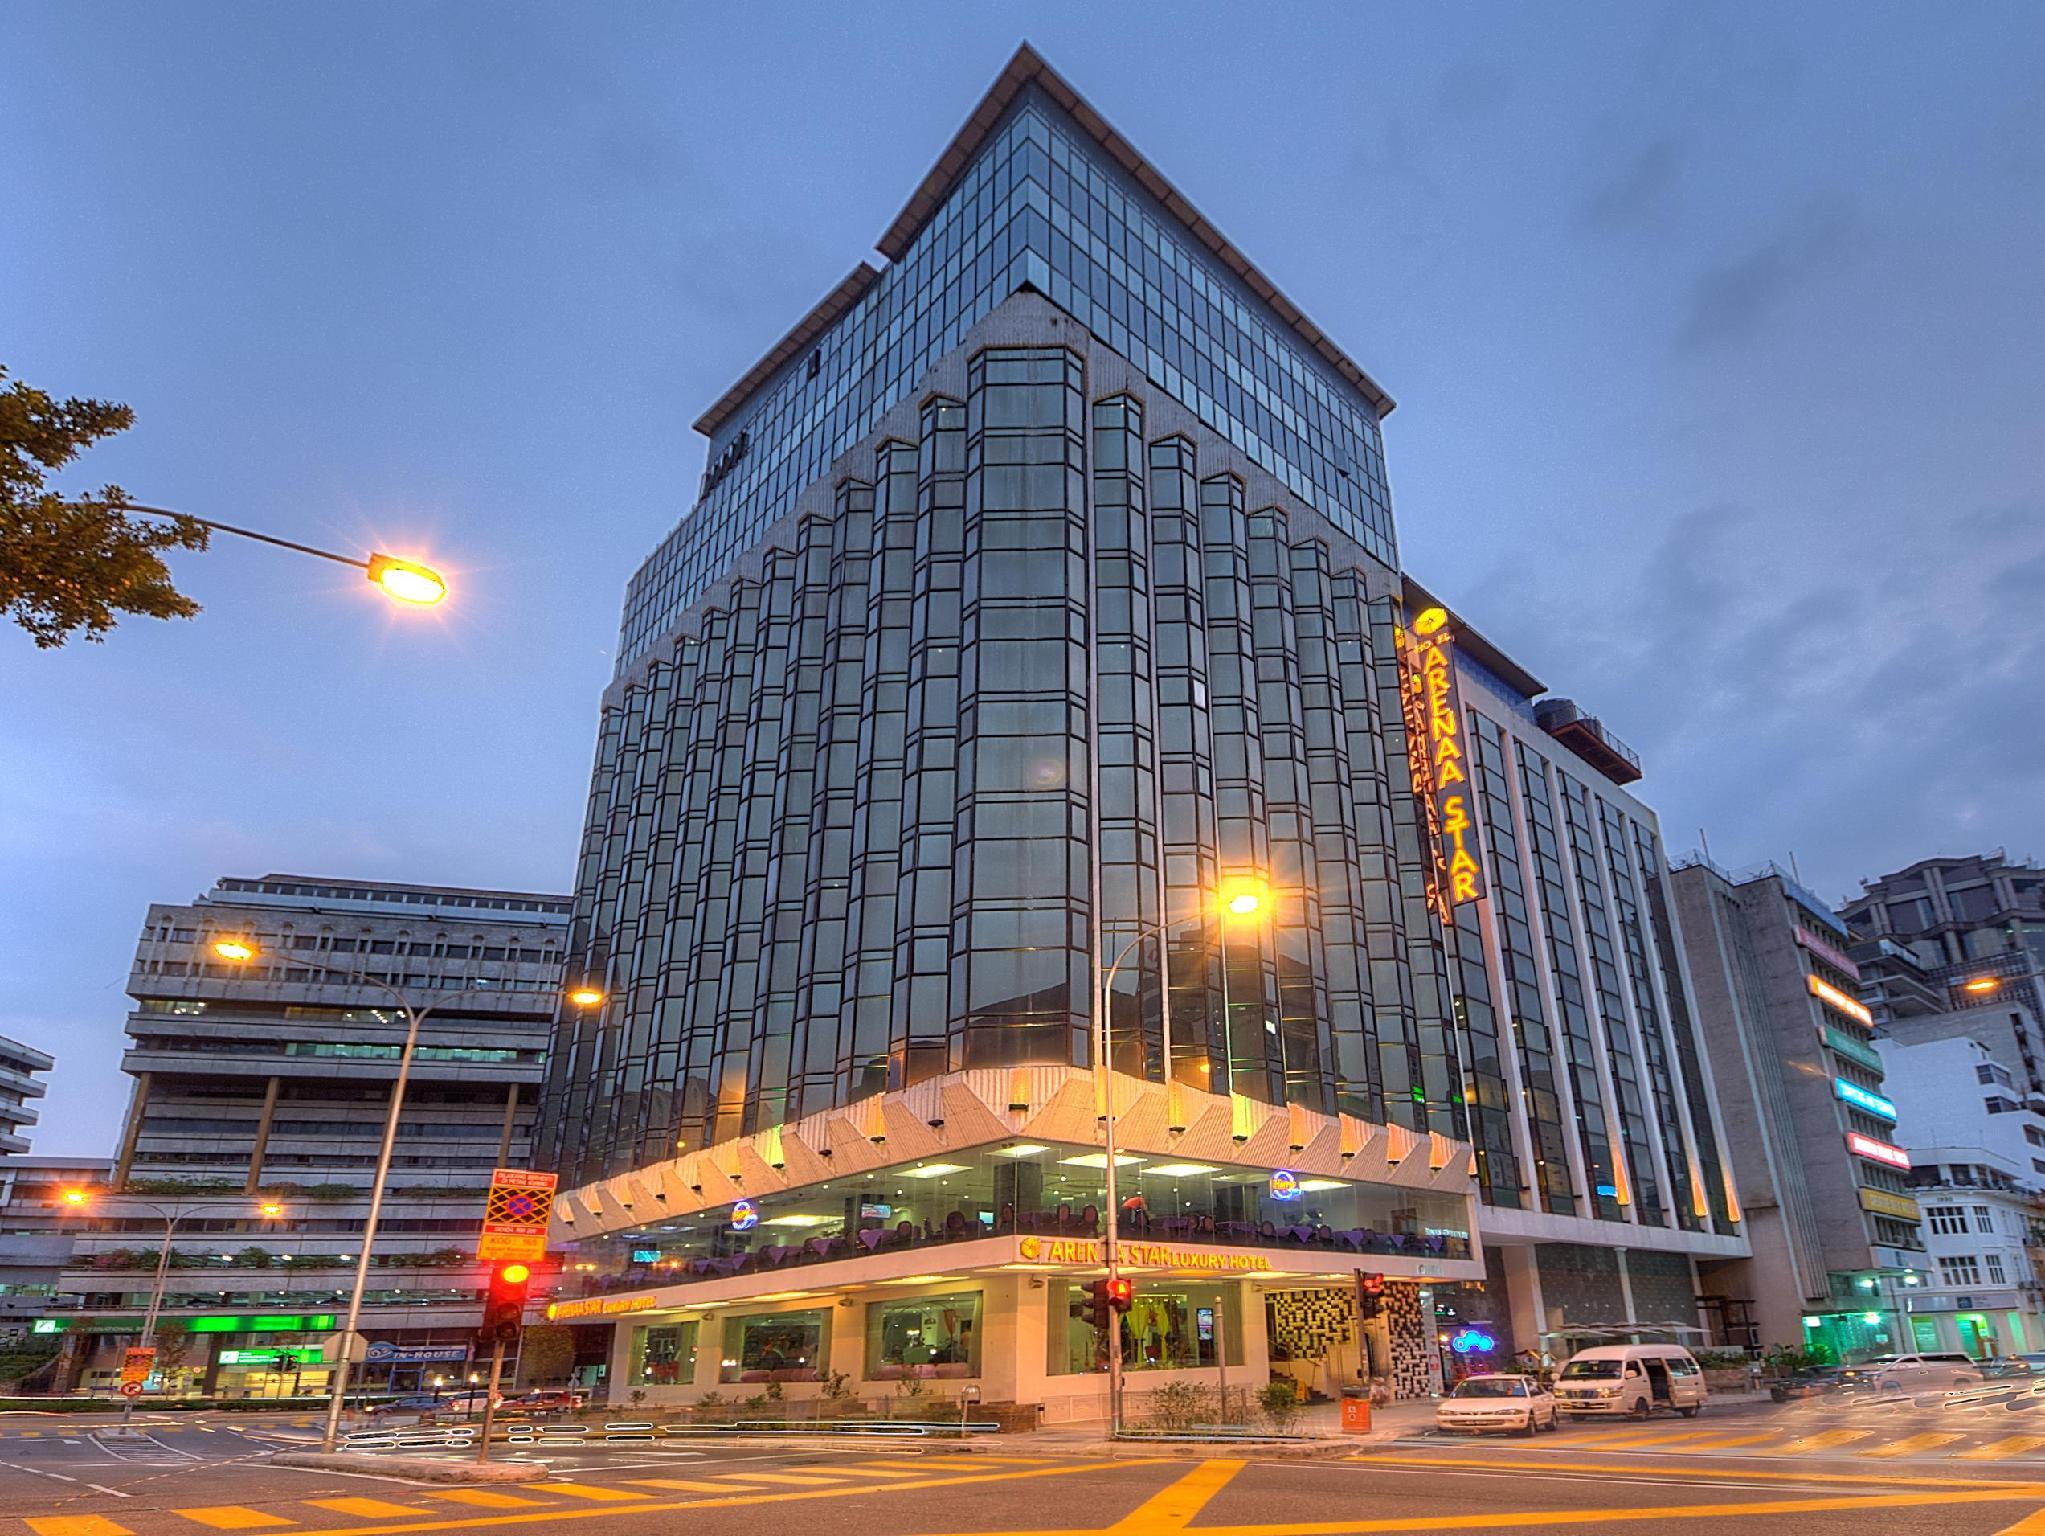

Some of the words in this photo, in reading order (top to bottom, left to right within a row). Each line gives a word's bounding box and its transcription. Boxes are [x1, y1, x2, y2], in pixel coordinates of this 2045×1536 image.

[1413, 632, 1451, 654] HOEL
[1424, 645, 1466, 790] ARENAA
[1443, 795, 1480, 903] STAR
[1050, 1240, 1125, 1264] ARENA
[1131, 1245, 1170, 1266] STAR
[1171, 1250, 1226, 1269] LUXURY
[1230, 1255, 1273, 1270] HOTEL
[394, 1350, 461, 1360] IN-HOUSE
